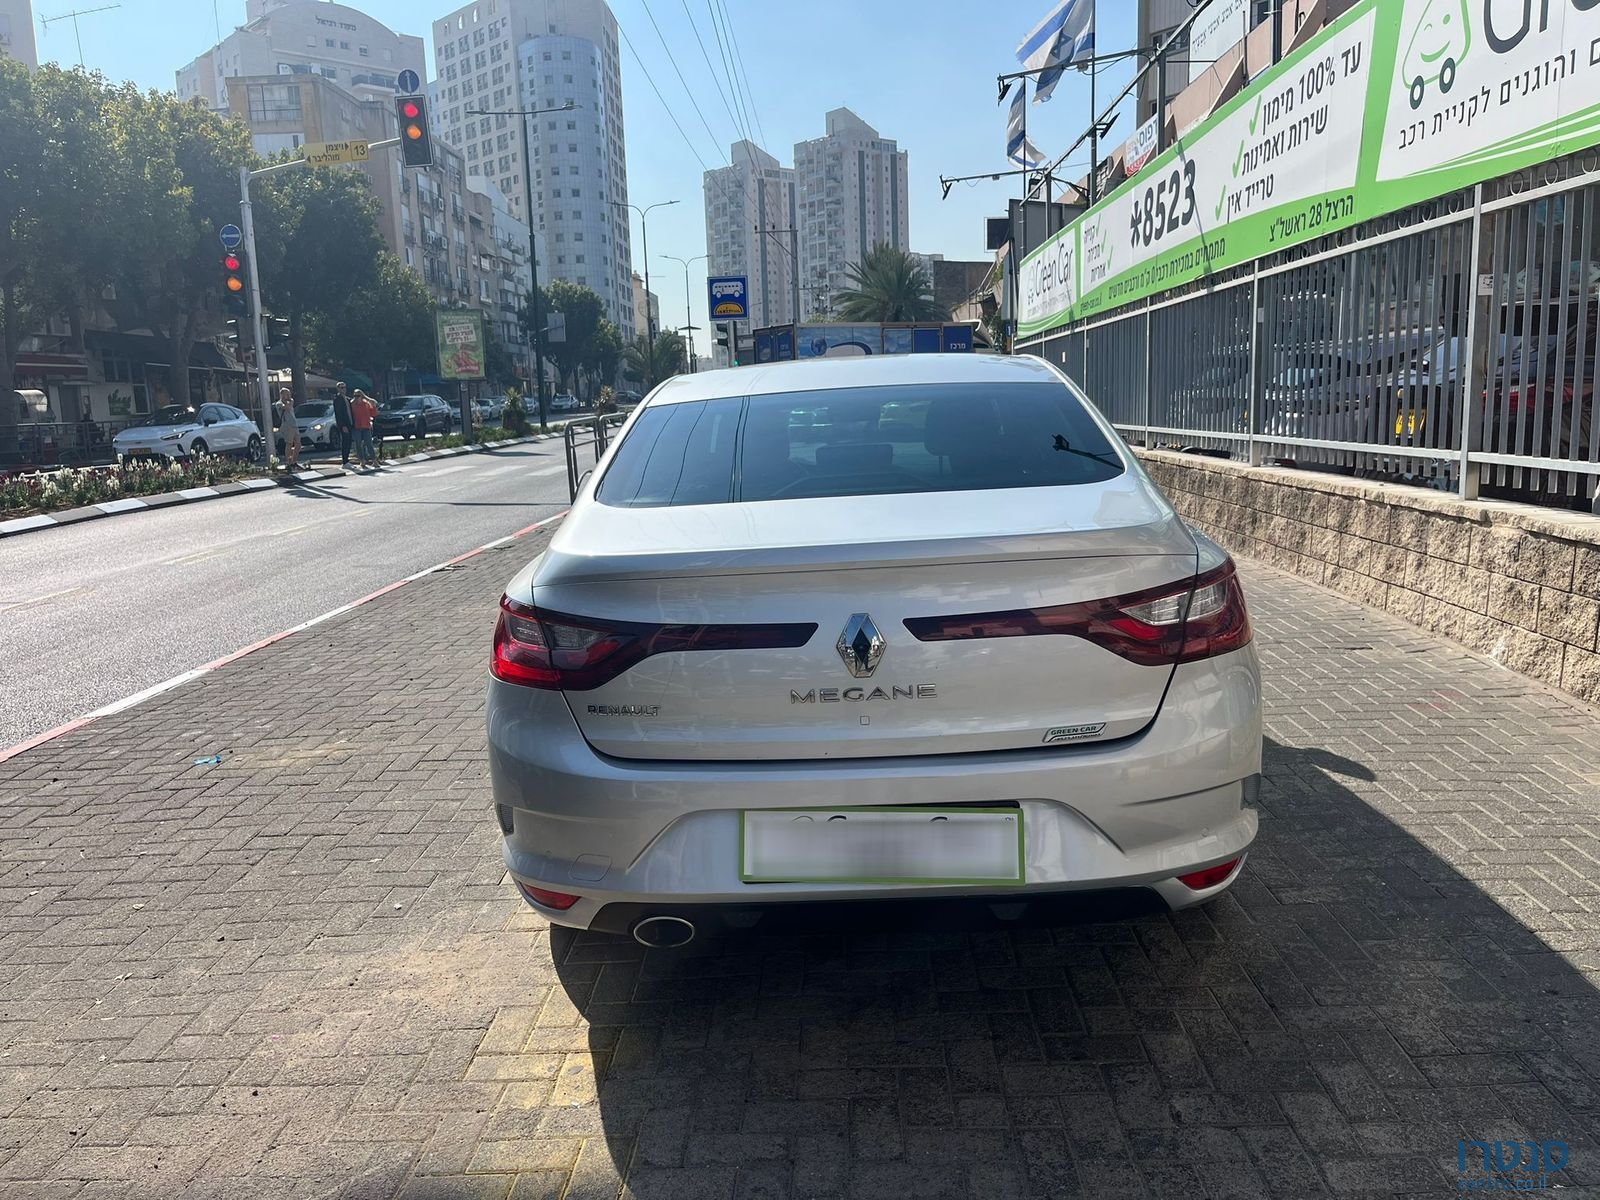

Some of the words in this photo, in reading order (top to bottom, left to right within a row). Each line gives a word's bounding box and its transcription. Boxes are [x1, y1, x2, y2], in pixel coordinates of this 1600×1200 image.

[1341, 42, 1362, 78] עד
[1298, 56, 1336, 105] 100%
[1499, 49, 1576, 106] והוגנים
[1262, 87, 1294, 136] מימון
[1431, 85, 1491, 136] לקניית
[1287, 104, 1329, 152] שירות
[1399, 120, 1425, 150] רכב
[312, 153, 340, 163] מוהליבר
[325, 143, 344, 154] ויצמן
[354, 144, 366, 156] 13
[1242, 130, 1285, 176] ואמינות
[1245, 173, 1274, 208] טרייד
[1226, 190, 1243, 225] אין
[1309, 202, 1322, 228] 28
[1325, 194, 1354, 223] הרצל
[1169, 252, 1194, 278] במכירת
[1196, 237, 1226, 266] מתמחים
[1035, 259, 1057, 297] Green
[1057, 242, 1074, 285] Car
[950, 342, 966, 350] מרכז
[790, 683, 938, 704] MEGANE
[587, 704, 661, 717] RENAULT
[1050, 727, 1079, 736] GREEN
